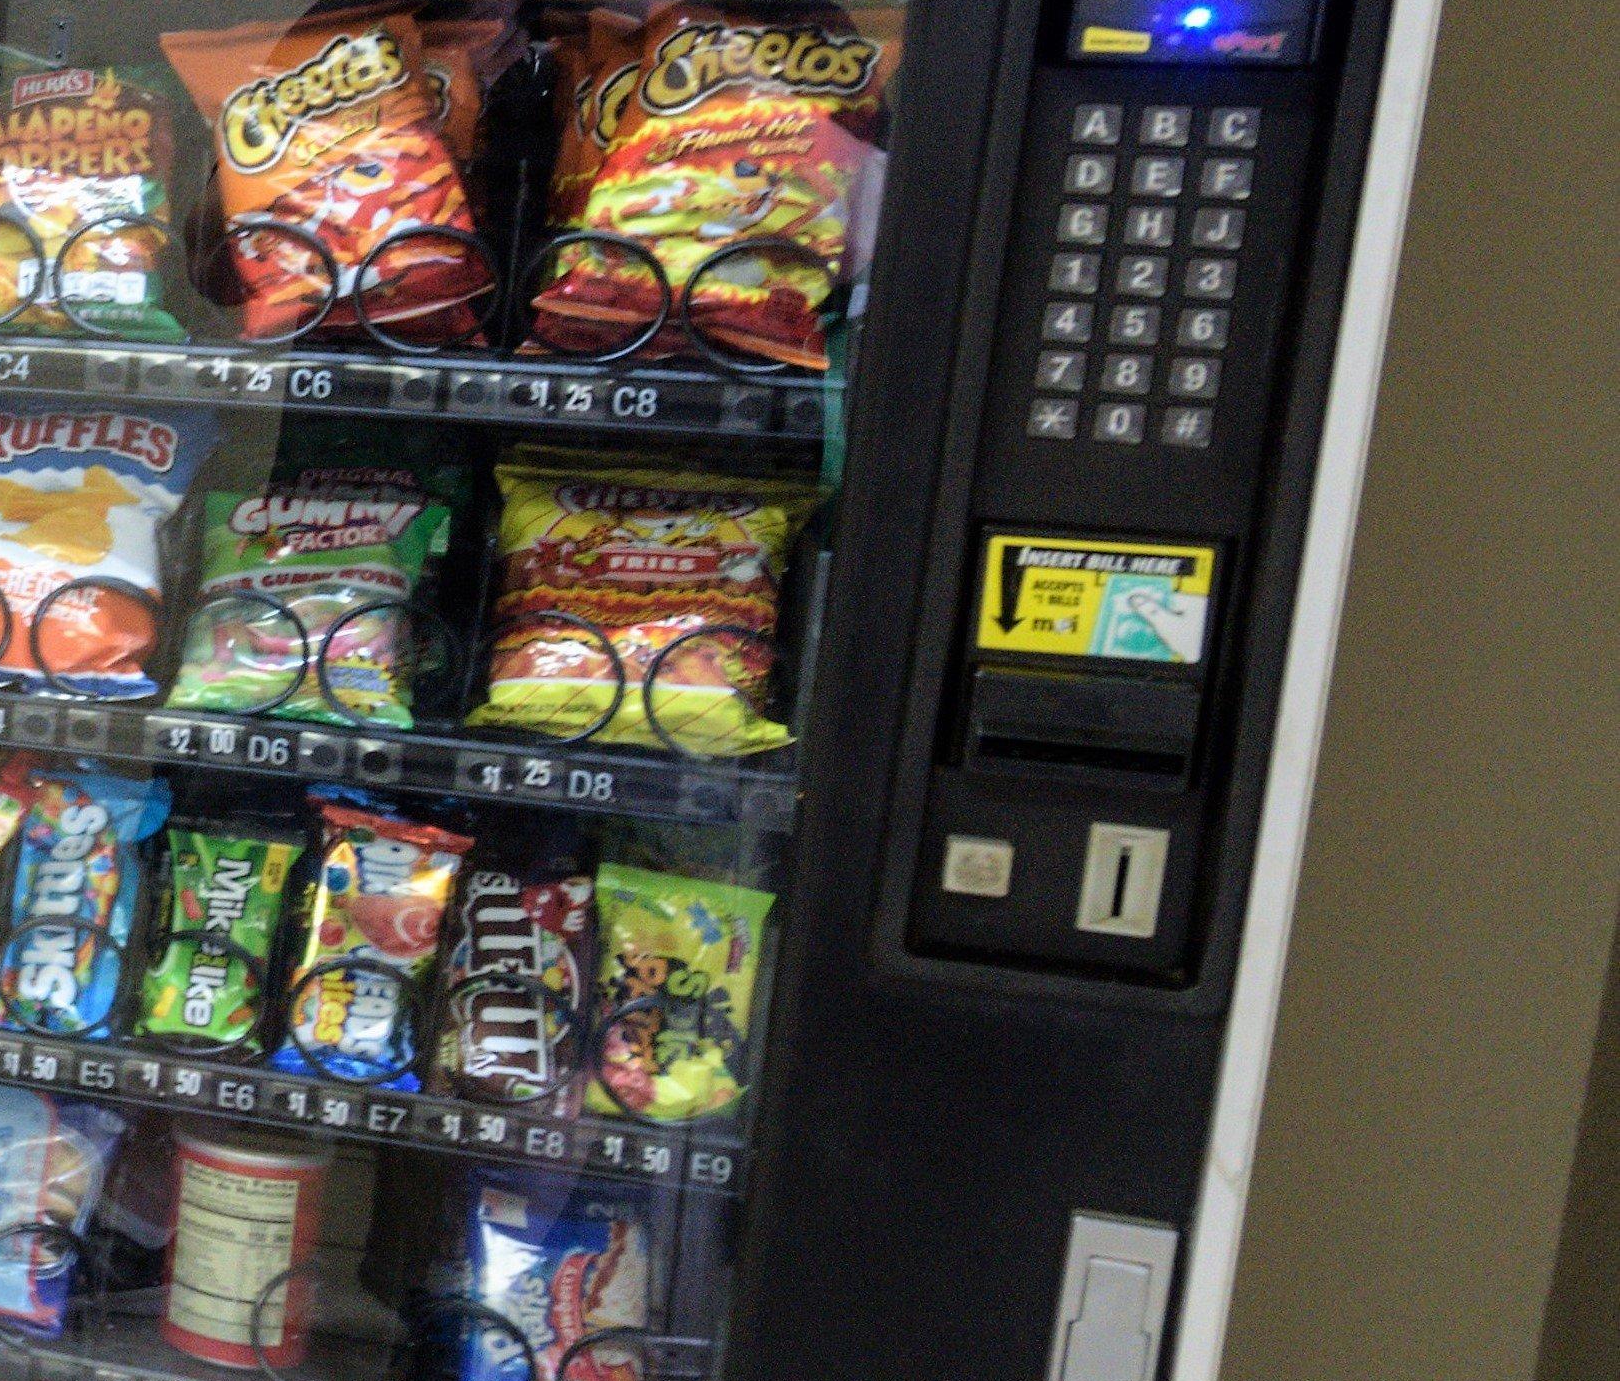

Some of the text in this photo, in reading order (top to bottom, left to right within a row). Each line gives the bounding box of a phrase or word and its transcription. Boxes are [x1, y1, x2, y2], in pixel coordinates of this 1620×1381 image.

[640, 22, 885, 117] Cheetos
[220, 27, 408, 174] Cheetos
[766, 114, 818, 136] Hot
[1083, 109, 1247, 142] A B C
[1076, 159, 1238, 192] D E F
[1069, 208, 1231, 243] G H J
[1066, 259, 1223, 291] 1 2 3
[1055, 307, 1214, 340] 4 5 6
[290, 368, 334, 399] C6
[1049, 356, 1208, 390] 7 8 9
[612, 384, 659, 417] C8
[285, 525, 393, 554] FACTORY
[609, 555, 697, 573] FRIES
[1017, 546, 1184, 575] INSERT BILL HERE
[247, 737, 291, 765] D6
[567, 771, 615, 803] D8
[17, 802, 110, 1010] Skittles
[79, 1059, 116, 1089] E5
[216, 1080, 256, 1111] E6
[368, 1103, 408, 1133] E7
[524, 1127, 566, 1159] E8
[689, 1151, 733, 1185] E9
